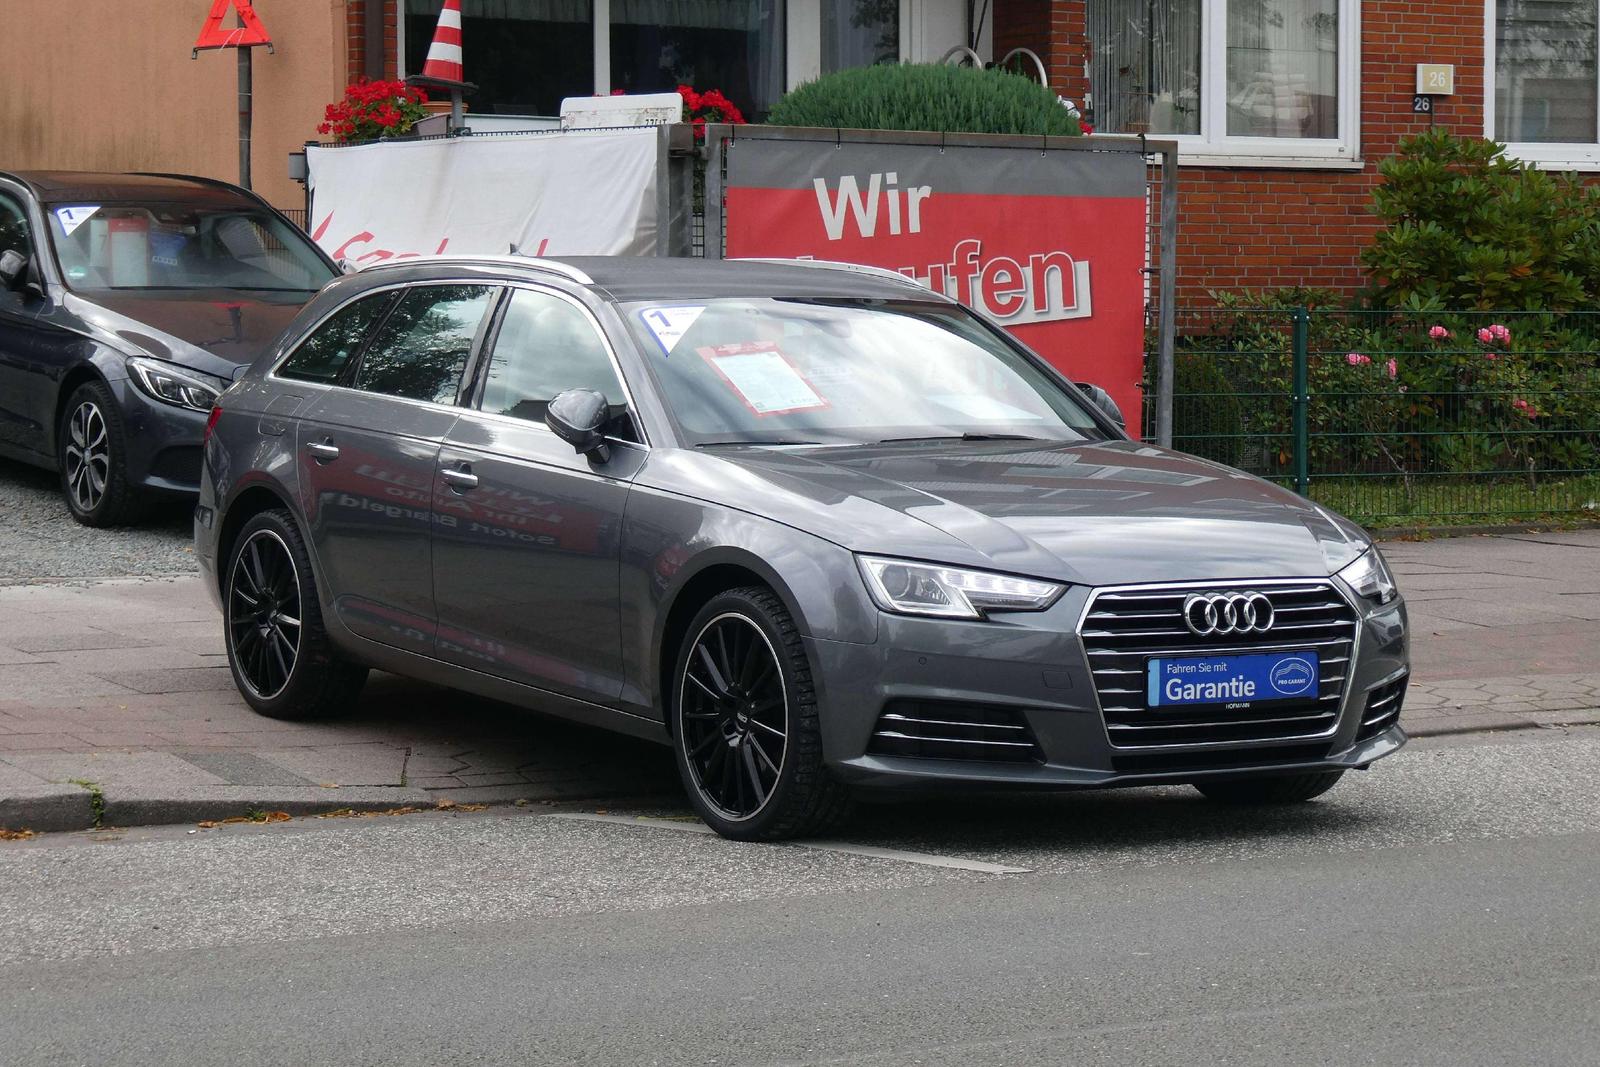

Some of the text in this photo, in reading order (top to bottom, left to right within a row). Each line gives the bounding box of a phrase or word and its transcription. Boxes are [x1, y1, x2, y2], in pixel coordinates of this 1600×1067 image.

[1430, 72, 1446, 87] 26
[1414, 97, 1430, 111] 26
[813, 171, 932, 241] Wir
[1167, 662, 1227, 674] Fahren Sie mit
[1165, 674, 1256, 701] Garantie
